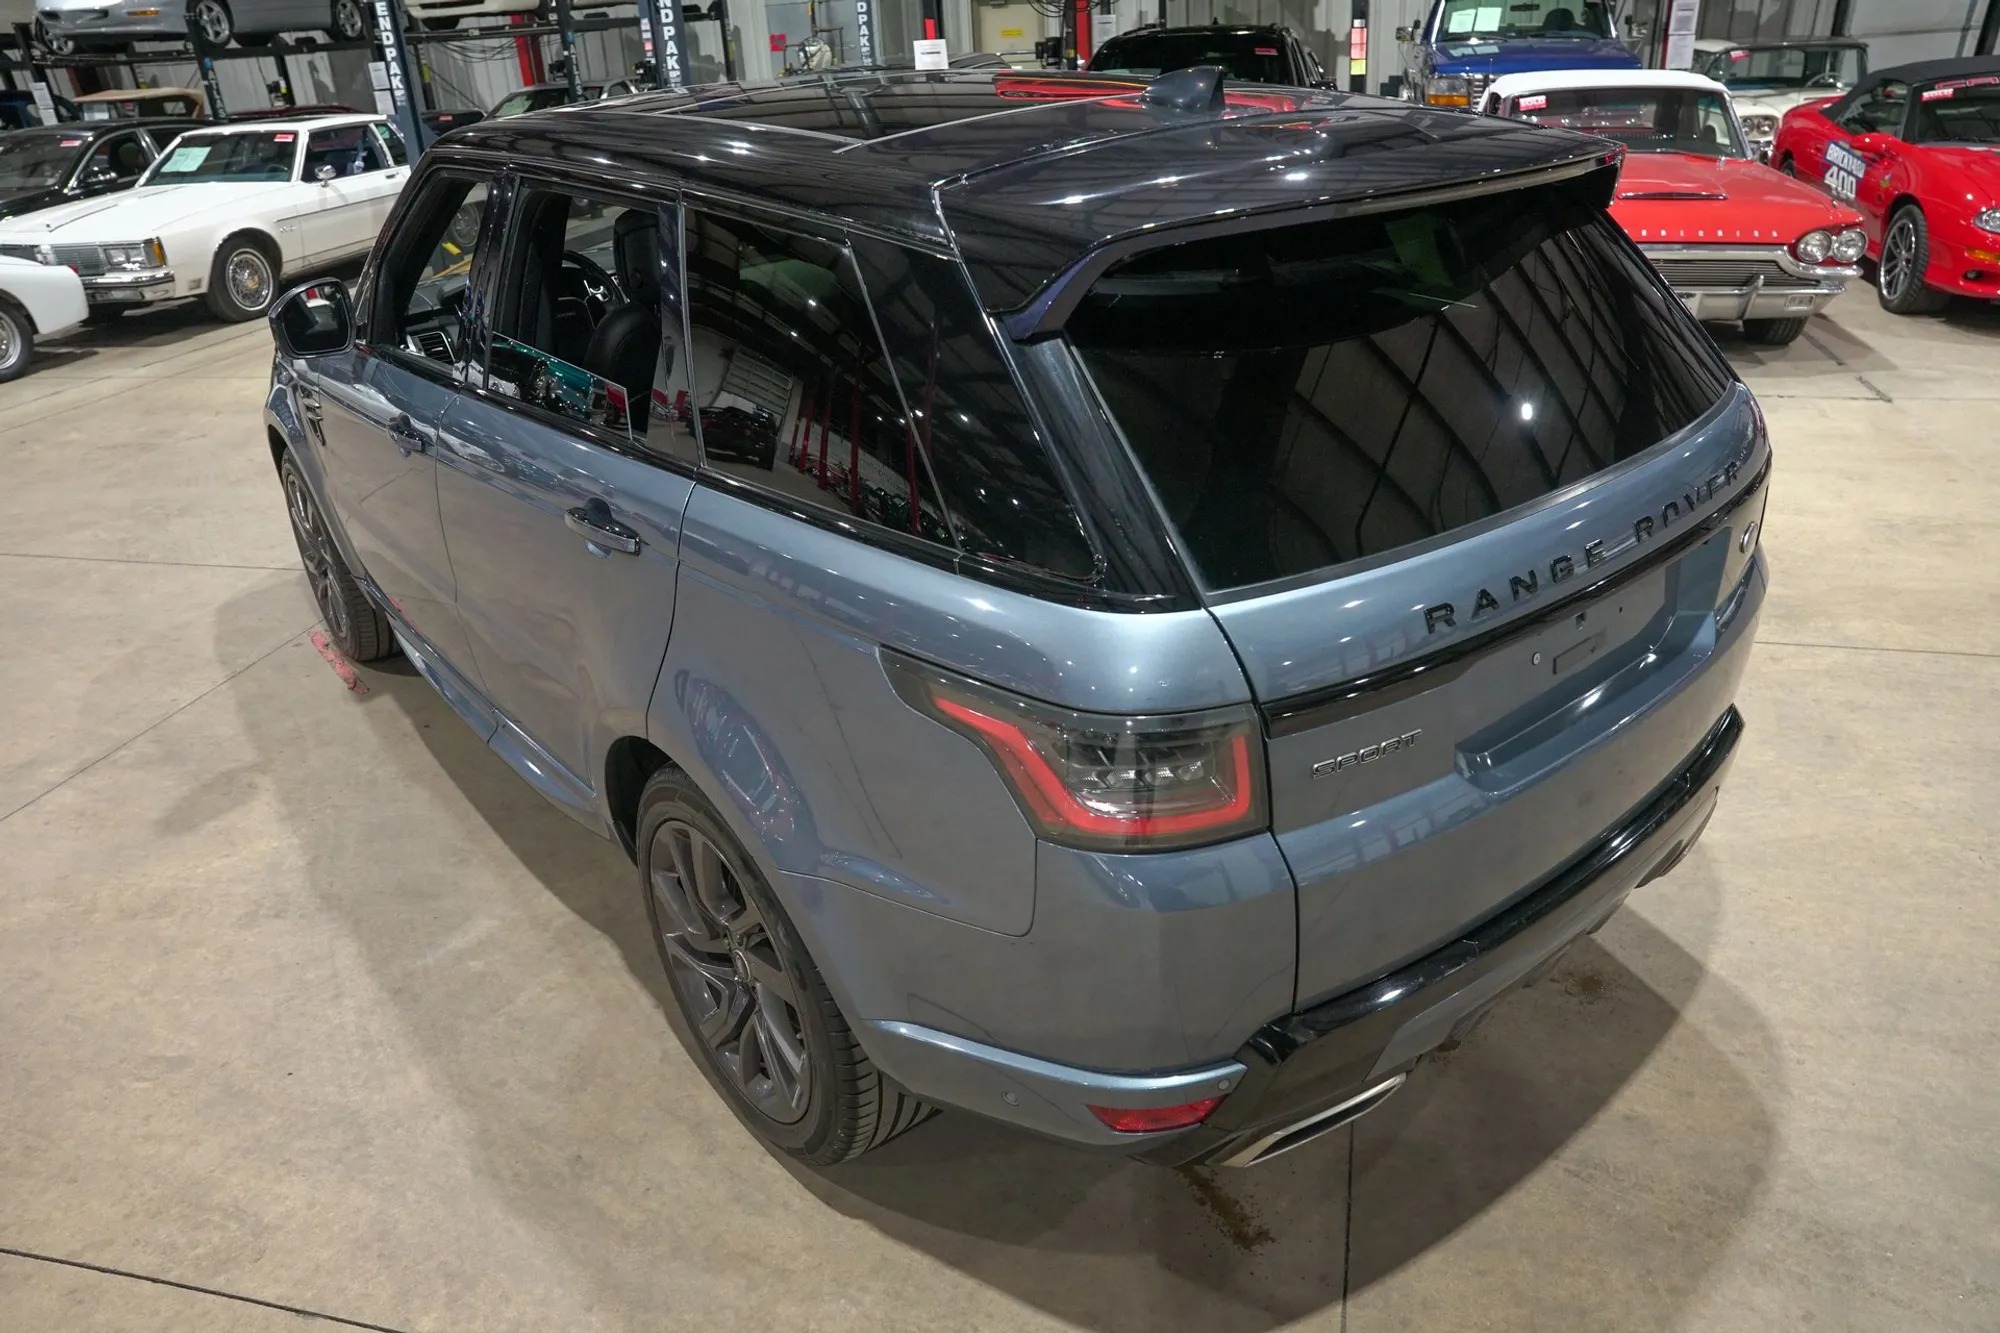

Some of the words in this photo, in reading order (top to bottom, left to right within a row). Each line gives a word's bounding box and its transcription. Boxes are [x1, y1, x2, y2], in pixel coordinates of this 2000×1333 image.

[1824, 164, 1856, 198] 400
[1424, 539, 1605, 635] RANGE
[1634, 461, 1742, 543] ROVER
[1312, 729, 1422, 779] SPORT
